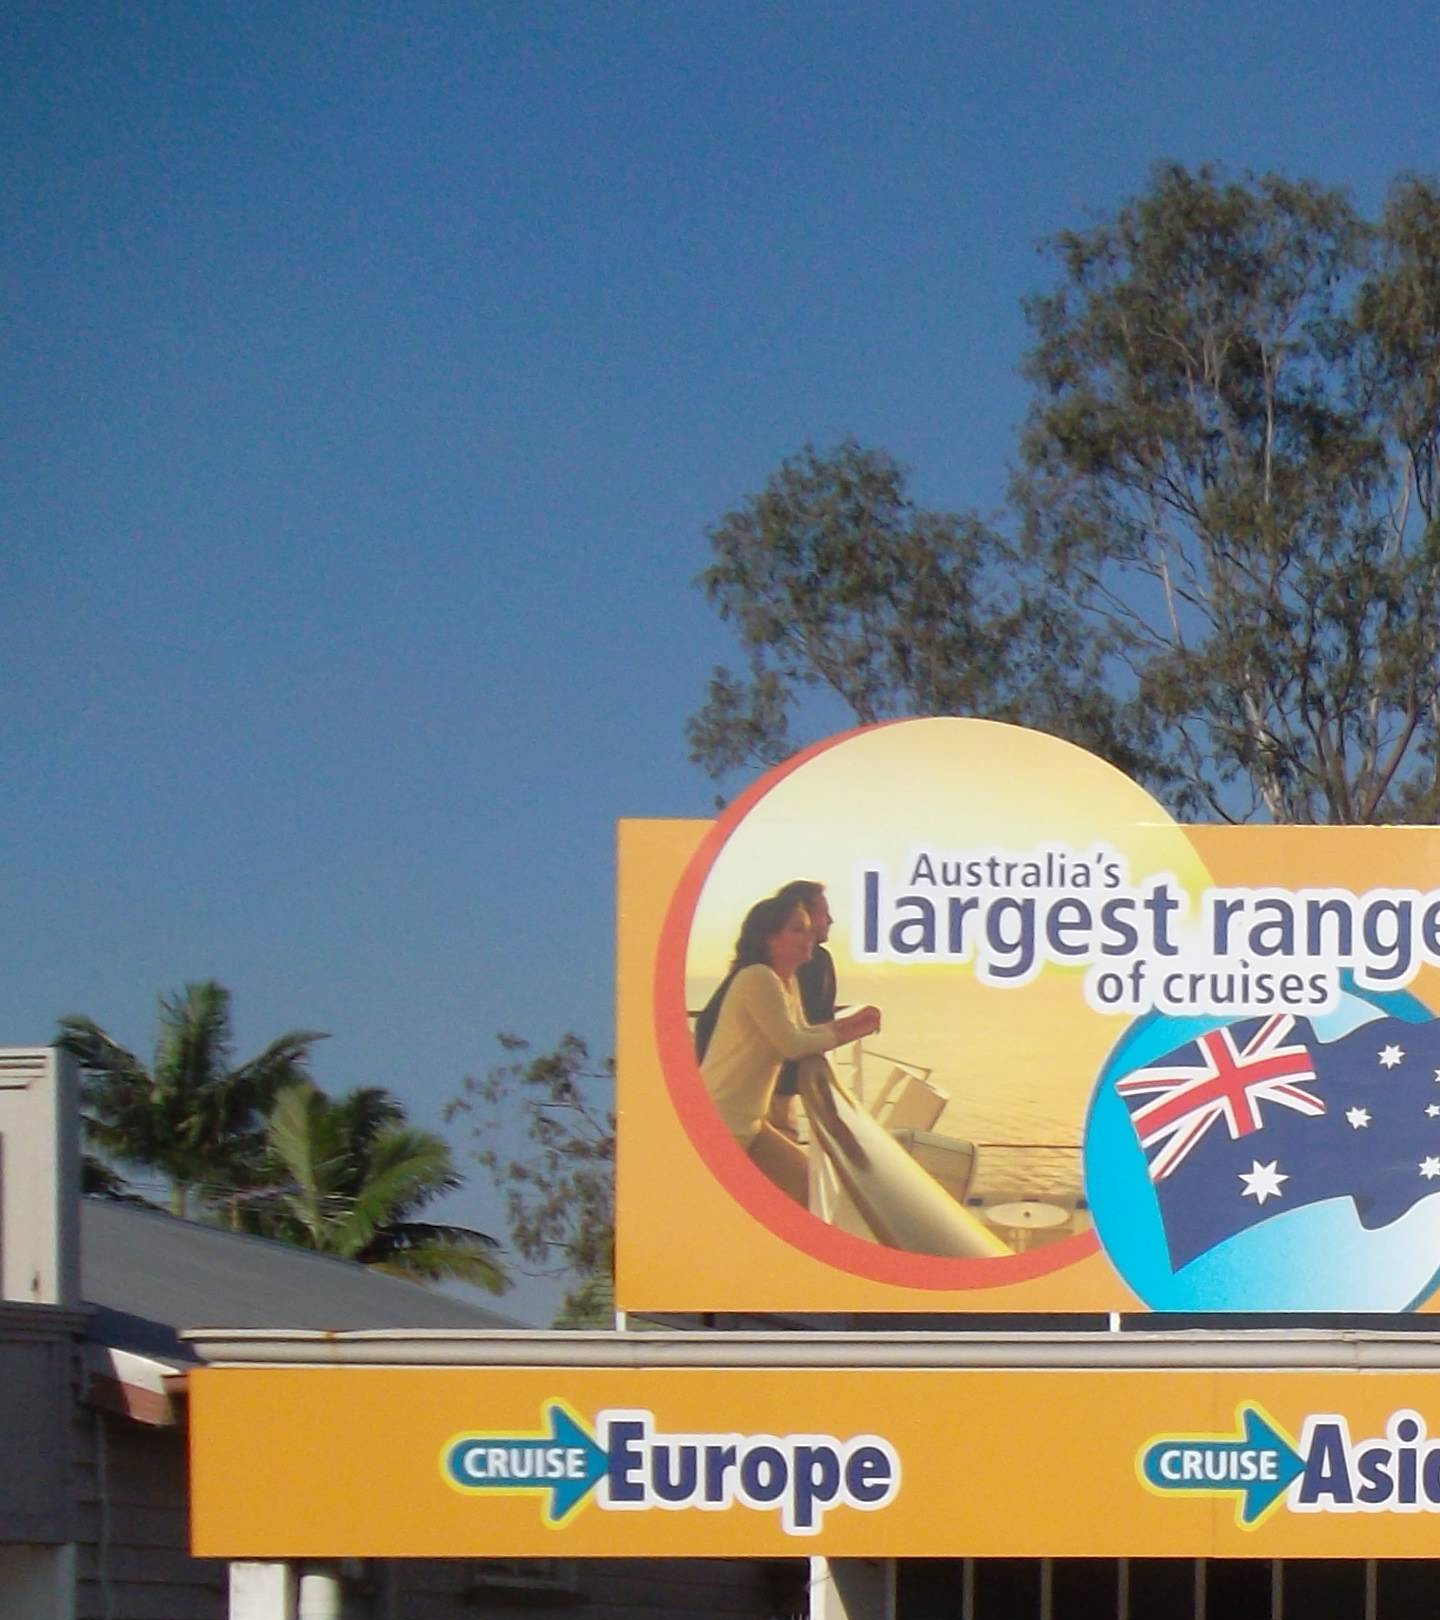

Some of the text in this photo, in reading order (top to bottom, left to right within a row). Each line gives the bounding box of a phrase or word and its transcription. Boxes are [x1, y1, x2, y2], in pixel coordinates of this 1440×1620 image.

[910, 852, 1120, 889] Australia's
[864, 871, 1178, 978] largest
[1097, 960, 1328, 1004] of cruises
[463, 1421, 891, 1527] CRUISE Europe
[1159, 1449, 1279, 1483] CRUISE
